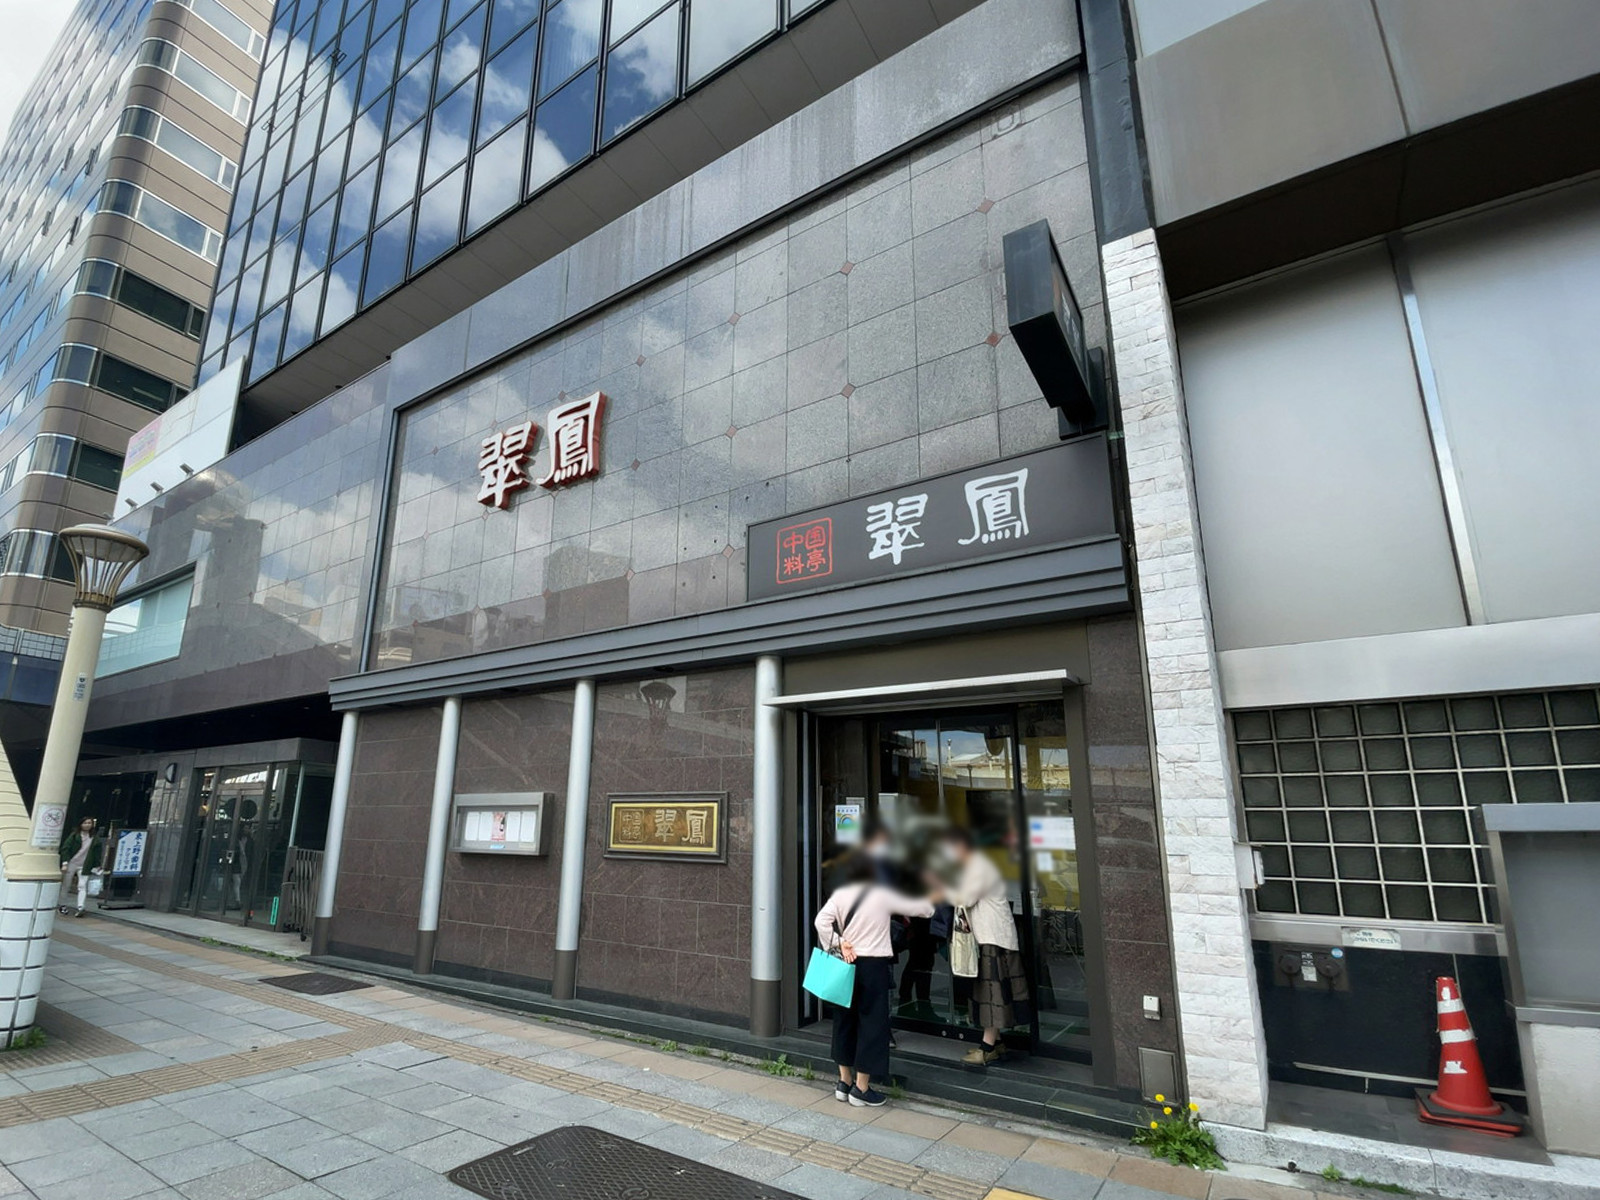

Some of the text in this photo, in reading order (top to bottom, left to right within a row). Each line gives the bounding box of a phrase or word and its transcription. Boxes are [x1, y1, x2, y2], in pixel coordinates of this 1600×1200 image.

[477, 391, 605, 508] 翠鳳
[865, 468, 1029, 565] 翠鳳
[783, 526, 826, 554] 中国
[783, 550, 826, 576] 料亭
[655, 809, 708, 845] 翠鳳
